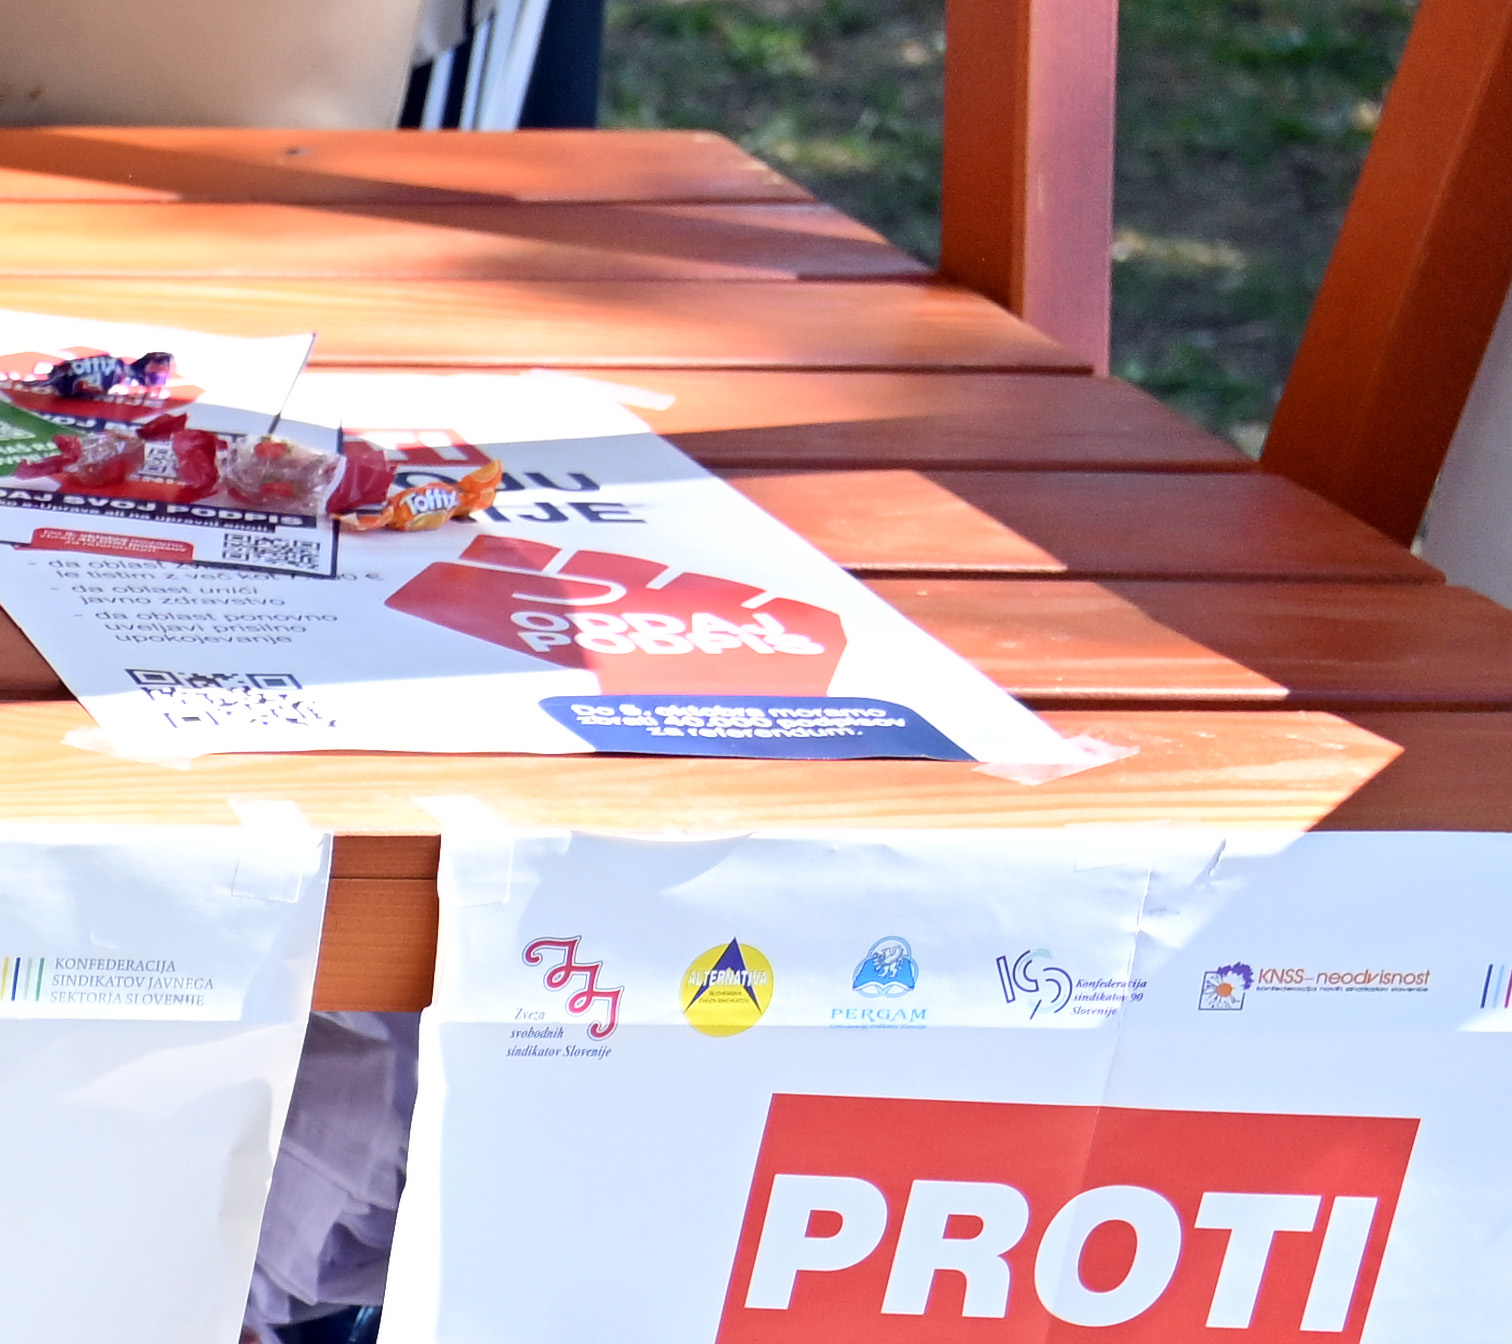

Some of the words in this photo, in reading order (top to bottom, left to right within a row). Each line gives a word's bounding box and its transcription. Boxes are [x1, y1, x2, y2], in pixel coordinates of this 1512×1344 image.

[64, 495, 156, 512] SVOJ
[166, 503, 303, 526] PODPIS
[400, 490, 459, 514] Toffix
[745, 1174, 1377, 1332] PROTI
